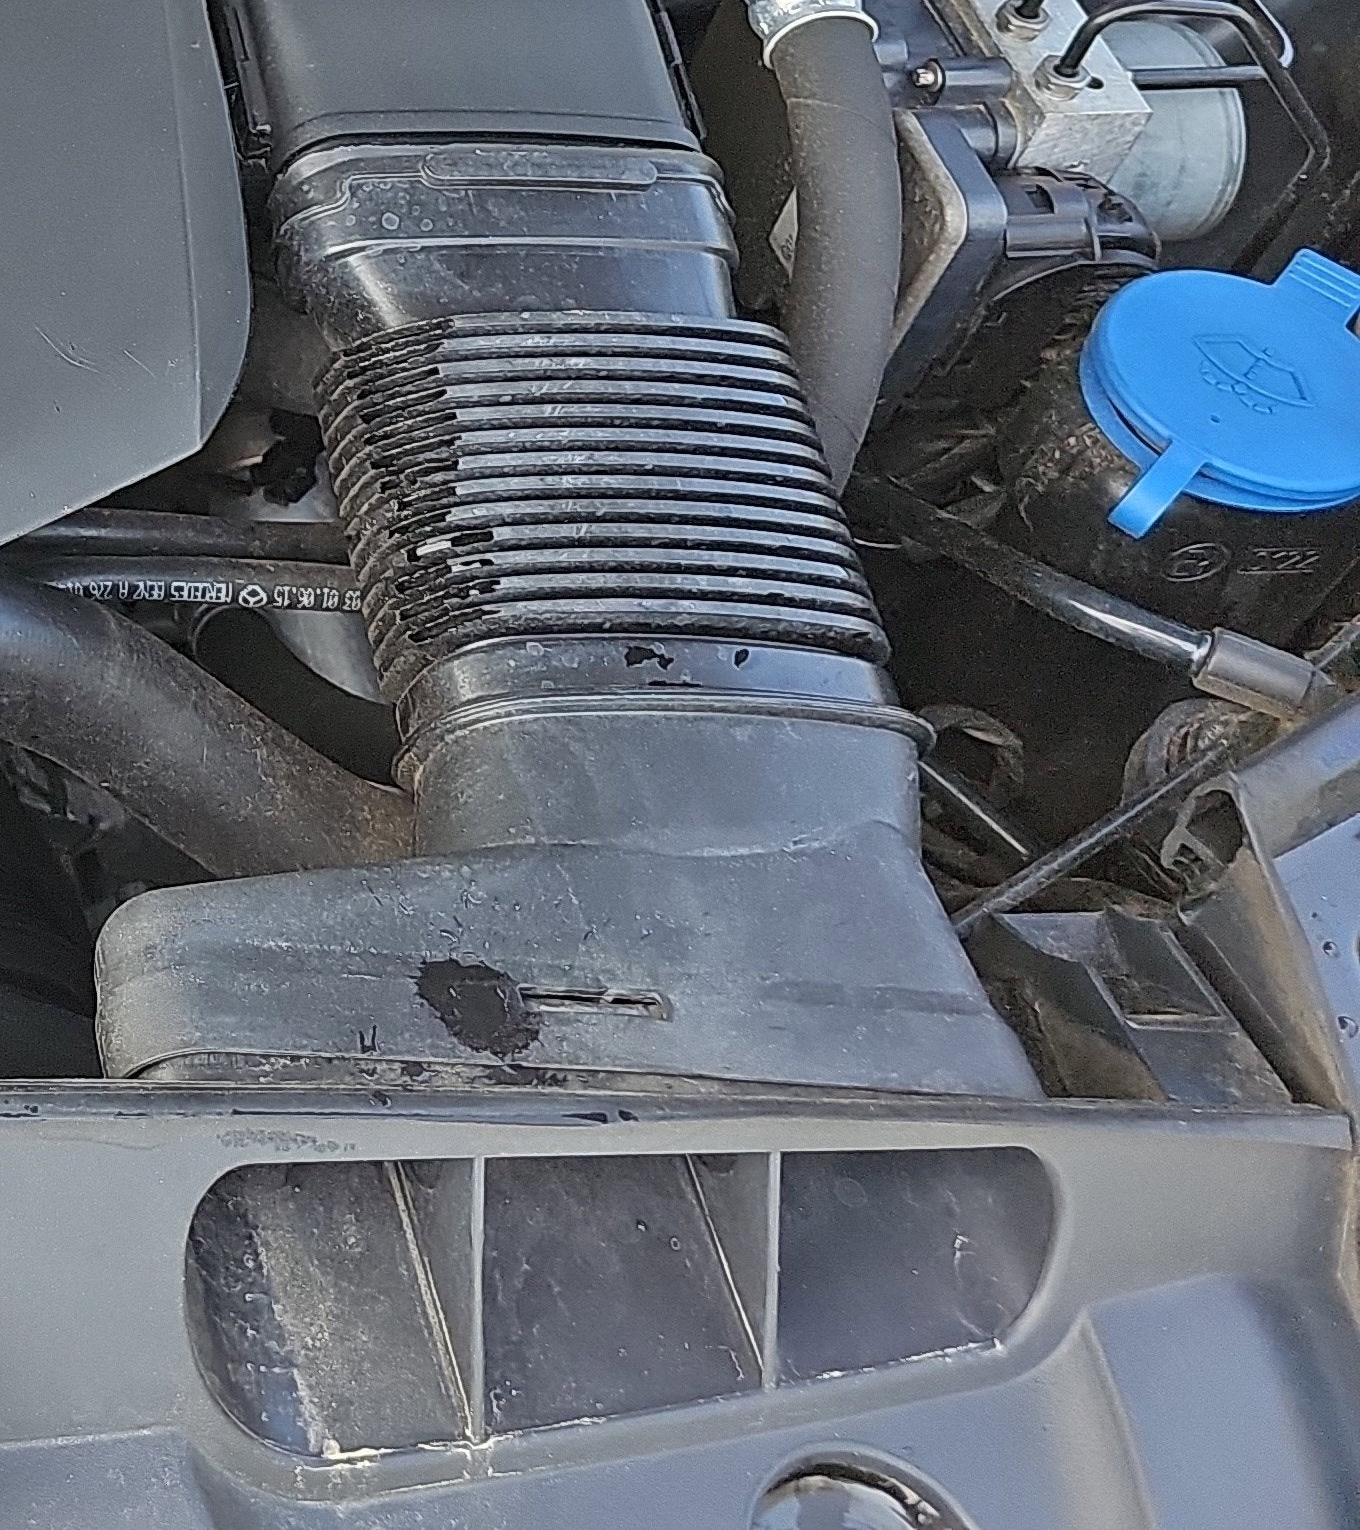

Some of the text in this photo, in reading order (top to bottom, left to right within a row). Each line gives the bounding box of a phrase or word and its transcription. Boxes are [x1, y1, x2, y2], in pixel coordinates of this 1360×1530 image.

[88, 580, 113, 600] 276
[118, 580, 129, 600] A
[133, 580, 165, 601] BENZ
[170, 580, 233, 603] MERCEDES
